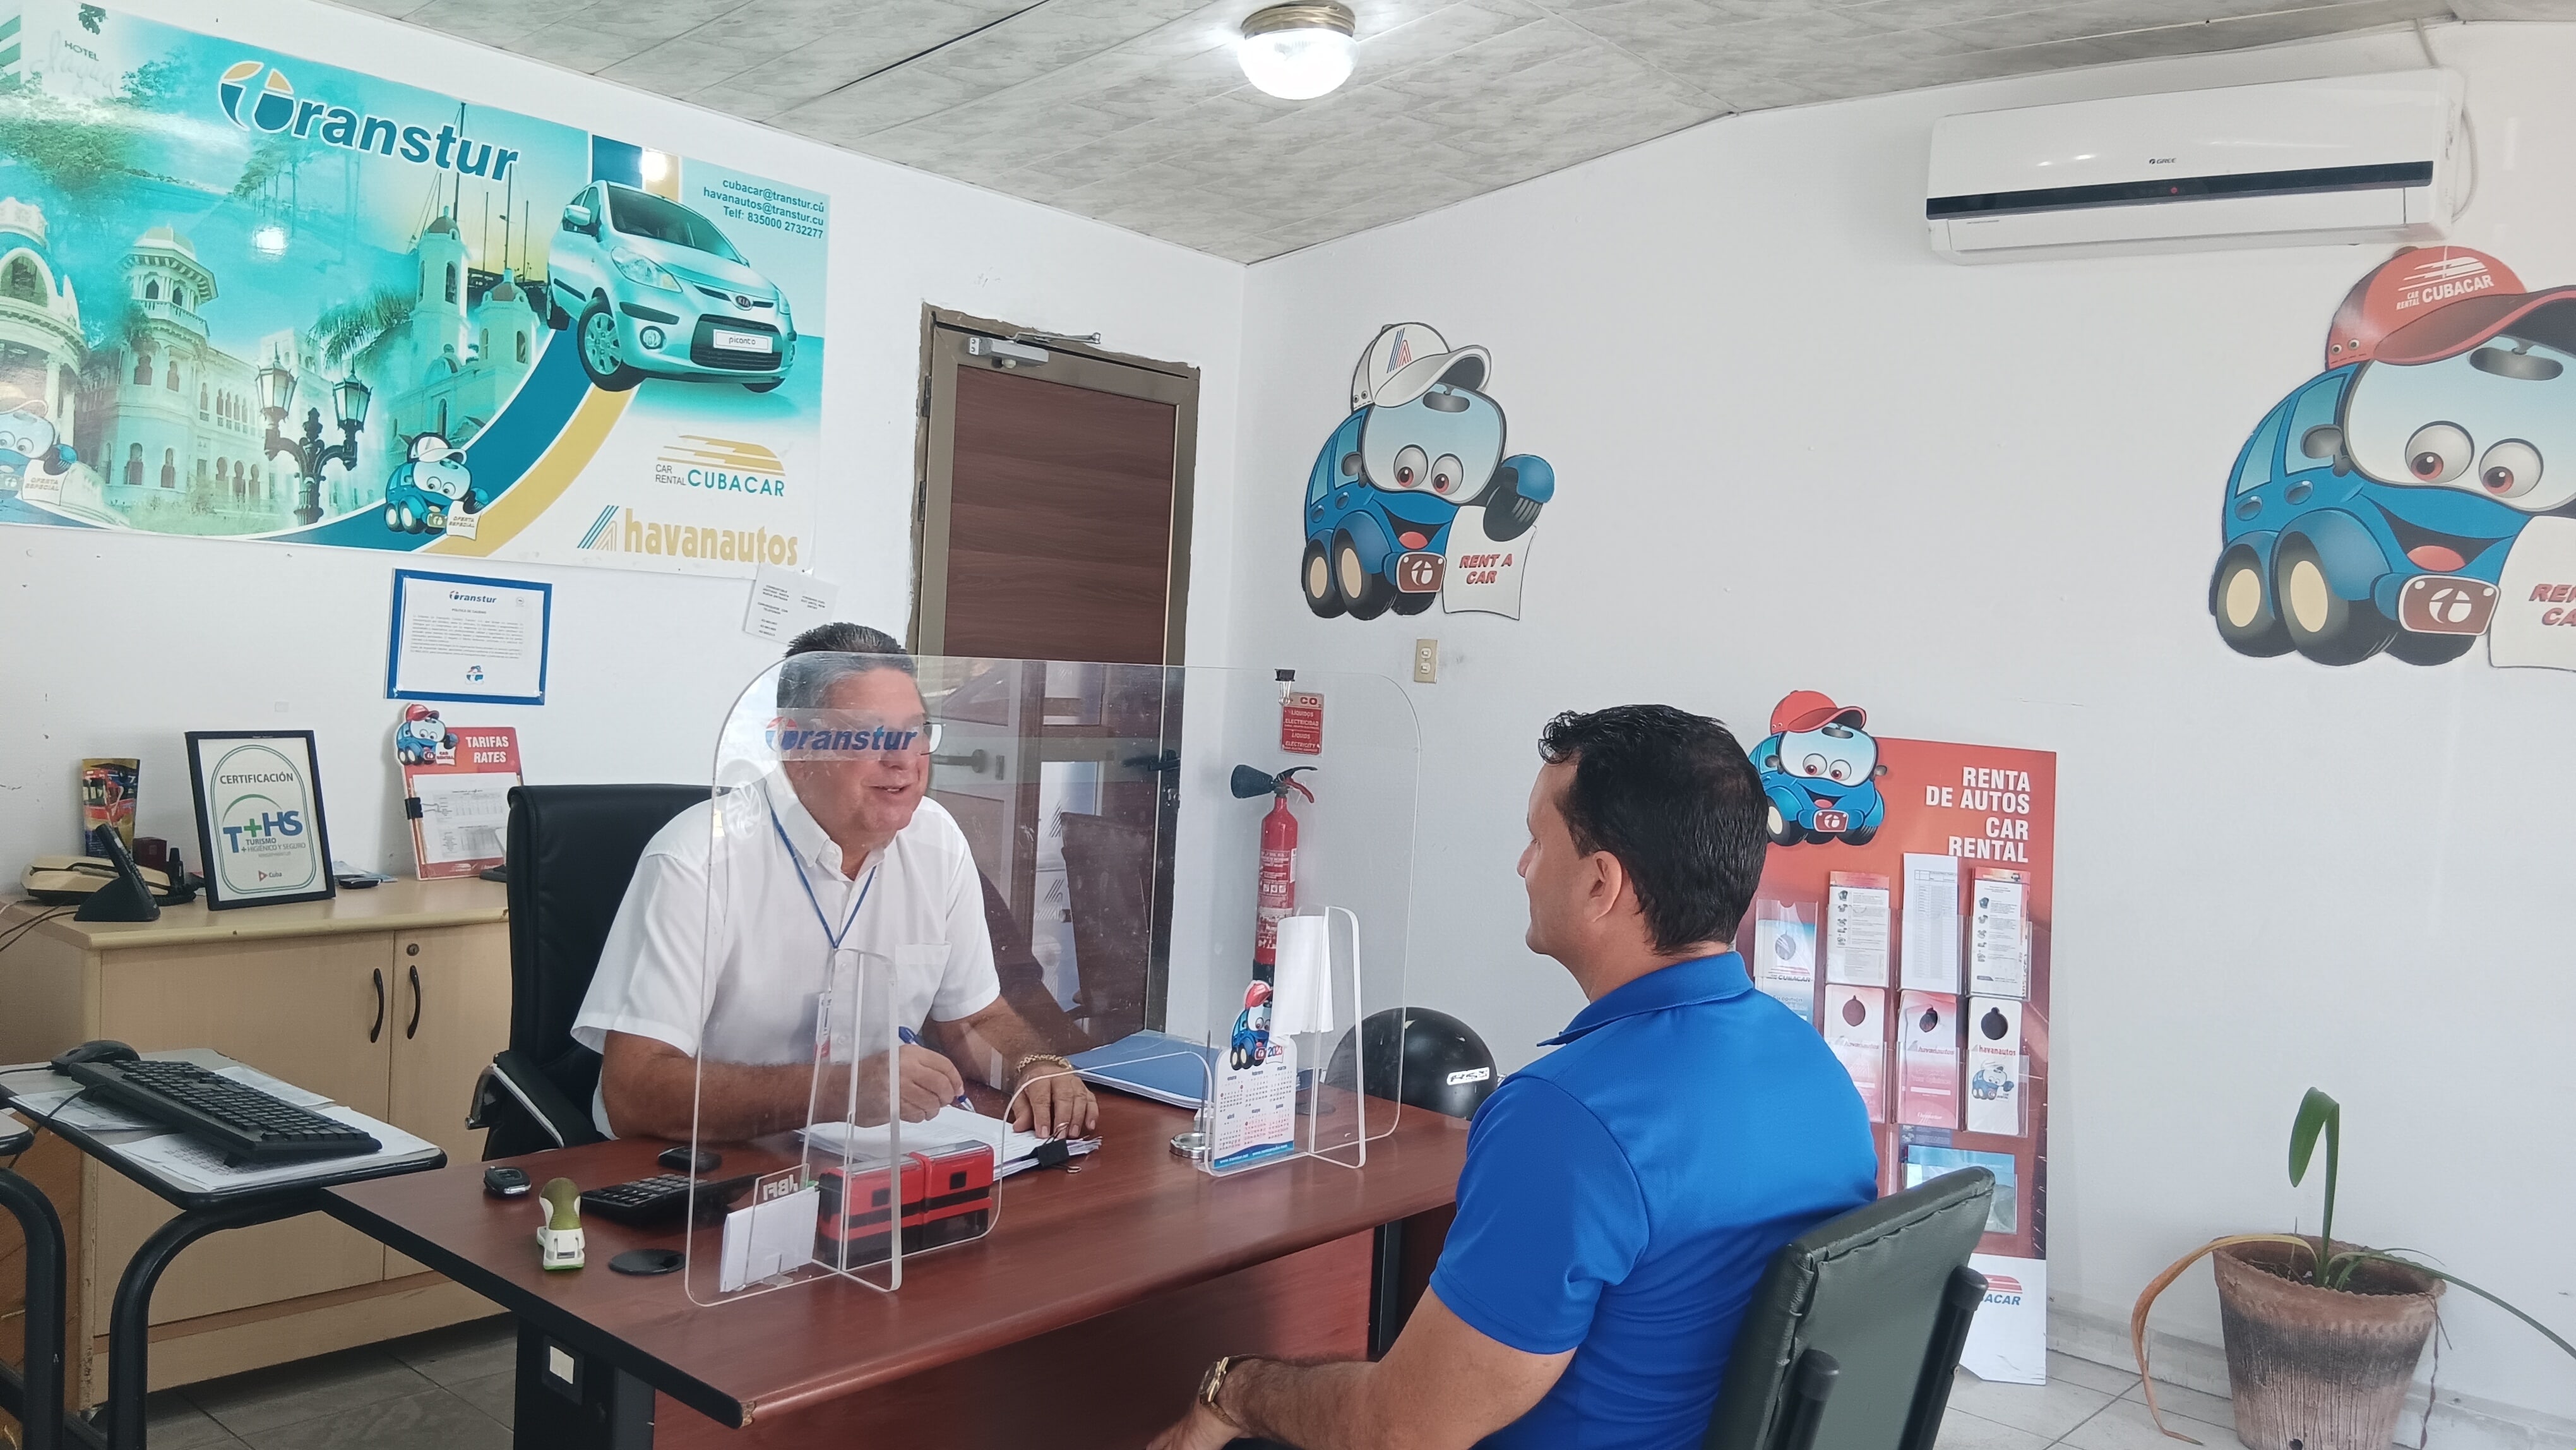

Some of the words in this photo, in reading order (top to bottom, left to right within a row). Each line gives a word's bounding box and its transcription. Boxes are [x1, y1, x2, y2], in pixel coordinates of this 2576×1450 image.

[64, 40, 99, 61] HOTEL
[703, 187, 824, 226] havanautos@transtur.cu
[723, 205, 744, 220] Telf:
[748, 212, 782, 229] 835000
[785, 221, 823, 239] 2732277
[2407, 291, 2419, 300] CAR
[2422, 275, 2495, 303] CUBACAR
[737, 297, 750, 308] KIA
[2396, 298, 2420, 311] RENTAL
[729, 337, 756, 345] picanto
[655, 464, 672, 474] CAR
[655, 474, 687, 486] RENTAL
[688, 469, 785, 497] CUBACAR
[624, 508, 798, 566] havanautos
[1458, 554, 1501, 568] RENT
[1501, 553, 1513, 567] A
[1466, 571, 1498, 584] CAR
[2528, 584, 2576, 603] RE
[2541, 608, 2576, 627] CA
[465, 736, 510, 748] TARIFAS
[474, 752, 507, 764] RATES
[220, 771, 294, 784] CERTIFICACIÓN
[1962, 766, 2030, 793] RENTA
[1926, 785, 1953, 808] DE
[1960, 789, 2030, 815] AUTOS
[1986, 817, 2029, 841] CAR
[246, 837, 277, 846] TURISMO
[282, 842, 307, 850] SEGURO
[1948, 836, 2029, 863] RENTAL
[1979, 1045, 2017, 1056] havanautos
[1984, 1293, 2021, 1306] ACAR
